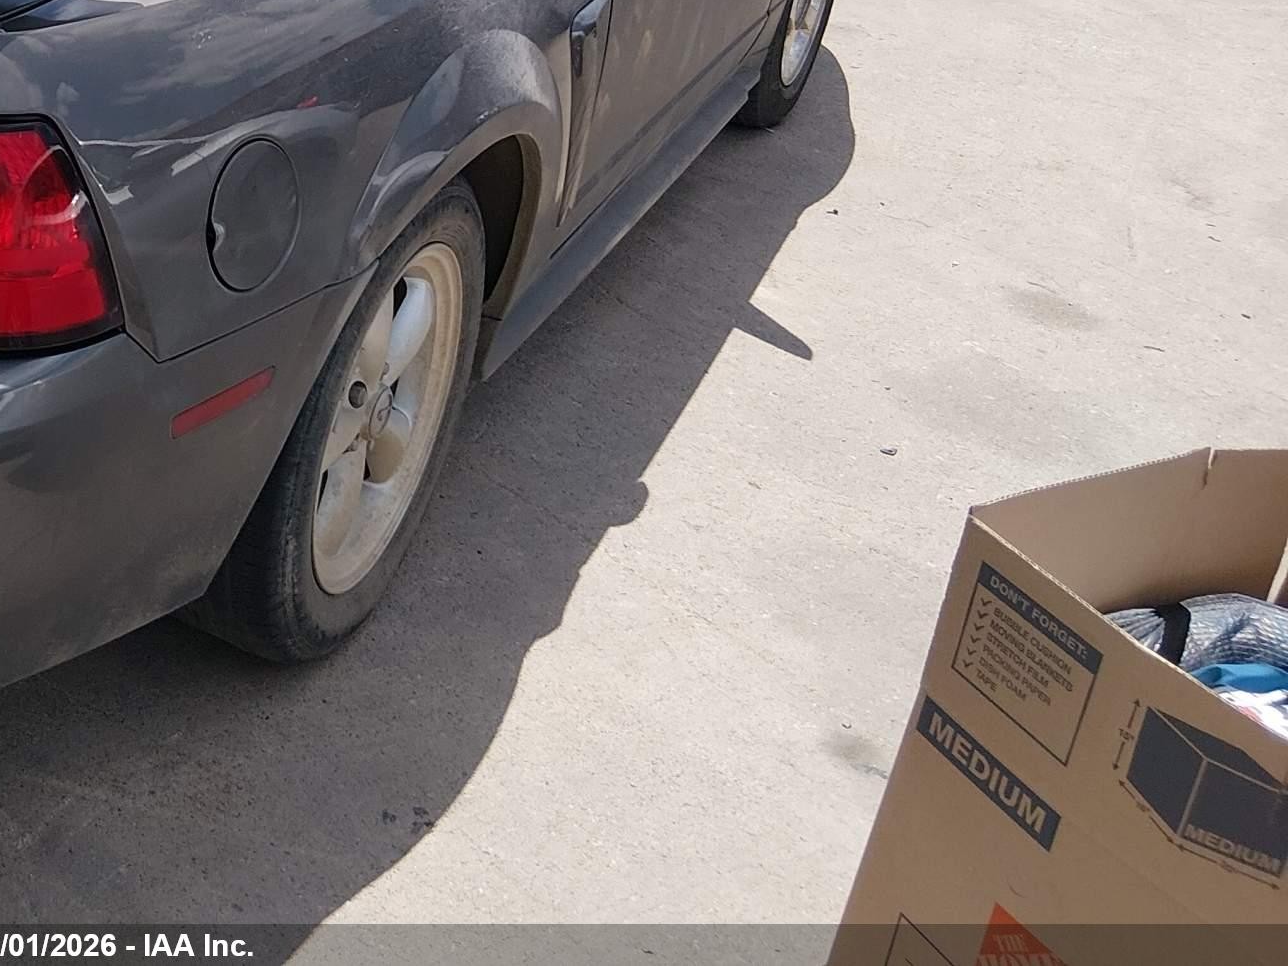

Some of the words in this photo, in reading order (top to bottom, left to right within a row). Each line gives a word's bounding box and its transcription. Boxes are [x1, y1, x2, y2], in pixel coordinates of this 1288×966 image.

[990, 575, 1031, 612] DON'T
[1031, 610, 1089, 660] FORGET:
[993, 607, 1029, 641] BUBBLE
[1030, 636, 1072, 675] CUSHION
[976, 667, 998, 692] TAPE
[982, 644, 1021, 680] PACKING
[1021, 676, 1051, 706] PAPER
[987, 632, 1027, 671] STRETCH
[1027, 664, 1049, 687] FILM
[990, 619, 1025, 653] MOVING
[1025, 648, 1073, 692] BLANKETS
[1000, 675, 1027, 701] FOAM
[928, 711, 1047, 835] MEDIUM
[1184, 824, 1281, 873] MEDIUM
